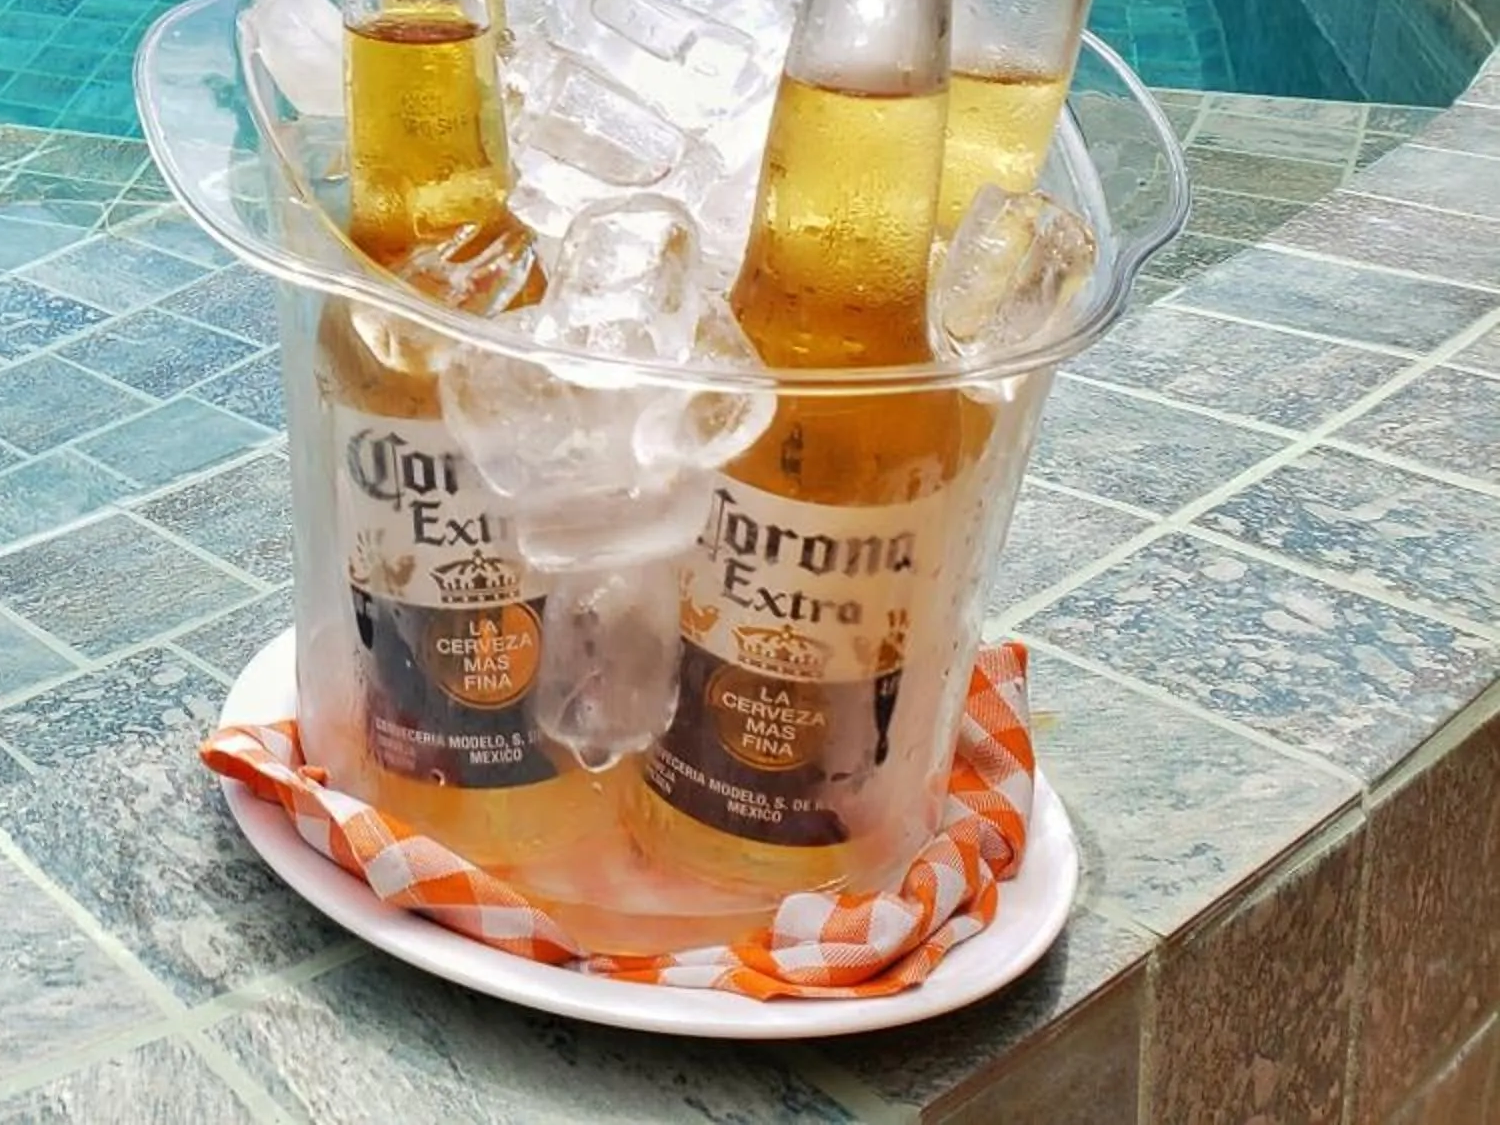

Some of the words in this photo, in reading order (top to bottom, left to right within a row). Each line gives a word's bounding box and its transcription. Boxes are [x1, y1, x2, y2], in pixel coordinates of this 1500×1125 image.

[347, 429, 464, 512] Cor
[721, 557, 862, 625] Extra
[469, 619, 498, 636] LA
[436, 631, 533, 655] CERVEZA
[463, 654, 510, 672] MAS
[464, 672, 512, 692] FINA
[760, 686, 790, 707] LA
[721, 691, 827, 727] CERVEZA
[745, 716, 797, 741] MAS
[469, 747, 524, 765] MEXICO
[741, 732, 794, 759] FINA
[726, 799, 783, 824] MEXICO
